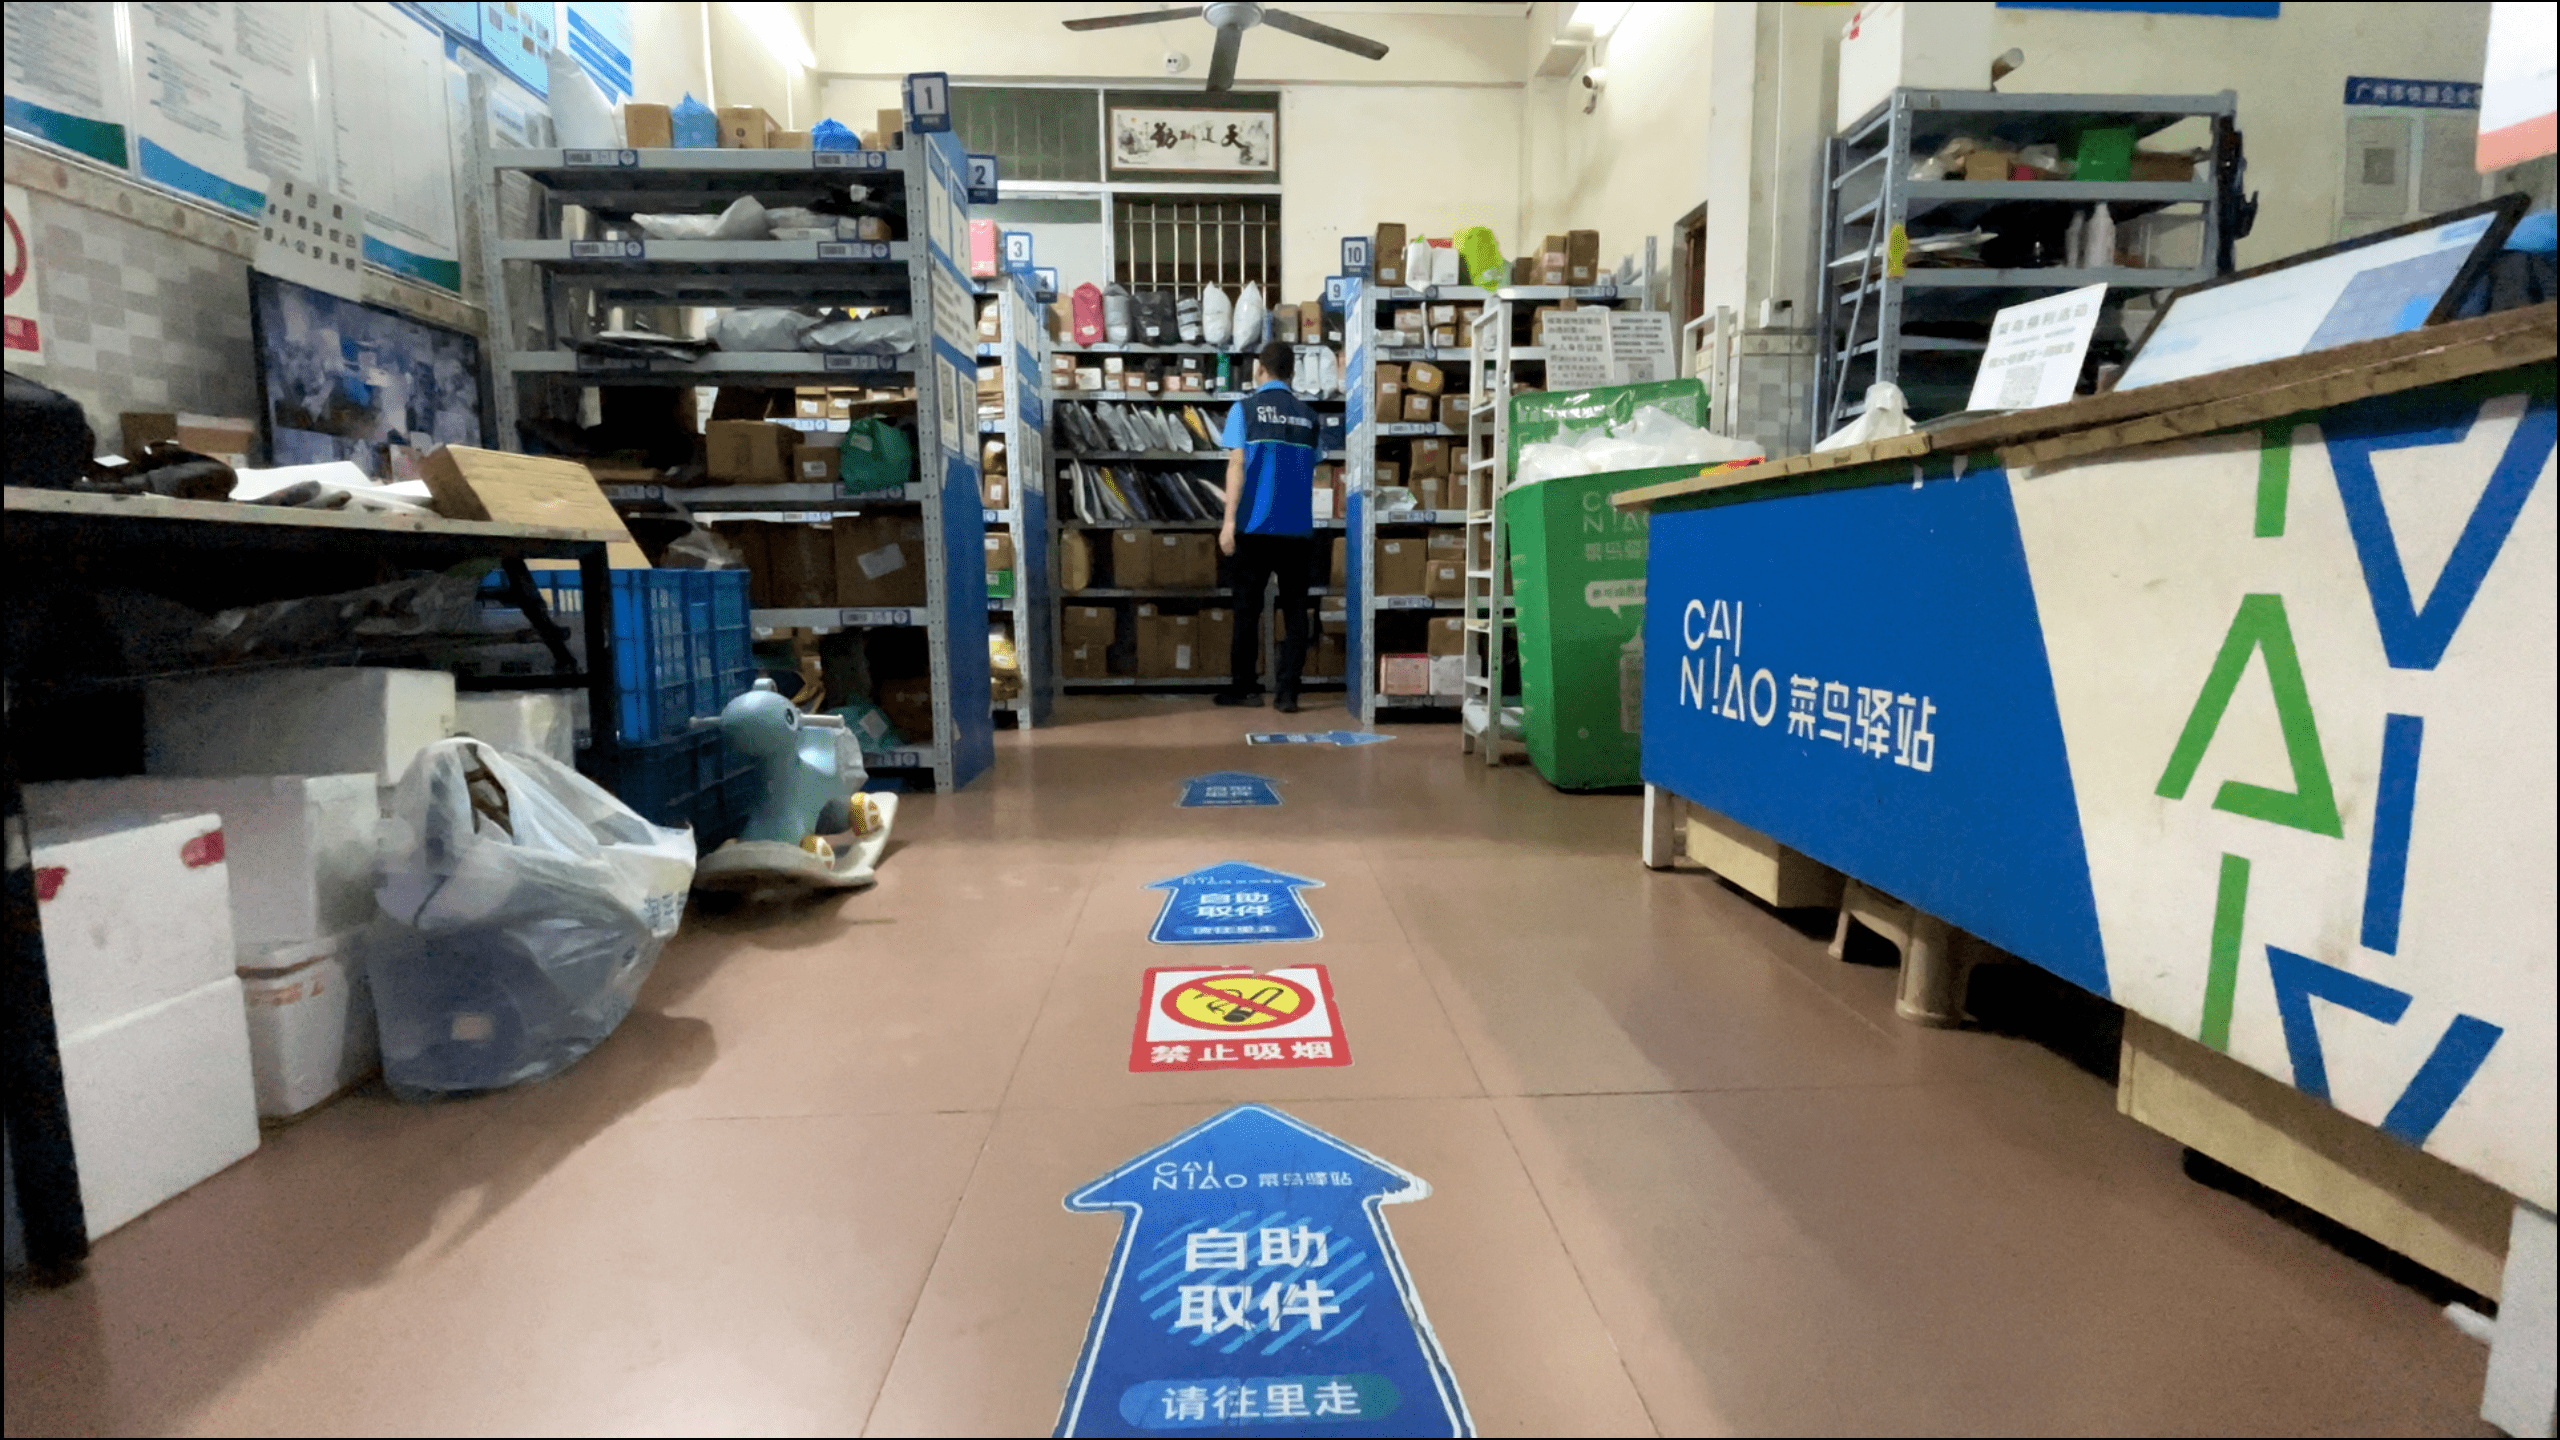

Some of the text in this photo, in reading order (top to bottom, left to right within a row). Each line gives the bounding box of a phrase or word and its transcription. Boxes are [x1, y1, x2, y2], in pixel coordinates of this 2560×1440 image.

[924, 86, 934, 111] 1
[974, 165, 986, 185] 2
[1013, 240, 1023, 258] 3
[1347, 246, 1362, 264] 10
[1332, 283, 1342, 298] 9
[1683, 599, 1743, 657] CAI
[1787, 673, 1938, 773] 菜鸟驿站
[1200, 892, 1270, 905] 自助
[1197, 905, 1272, 918] 取件
[1151, 1041, 1333, 1063] 禁止吸烟
[1155, 1161, 1213, 1176] CAI
[1153, 1171, 1354, 1190] NIAO 菜鸟驿站
[1184, 1226, 1329, 1272] 自助
[1173, 1280, 1341, 1334] 取件
[1162, 1381, 1362, 1422] 请往里走
